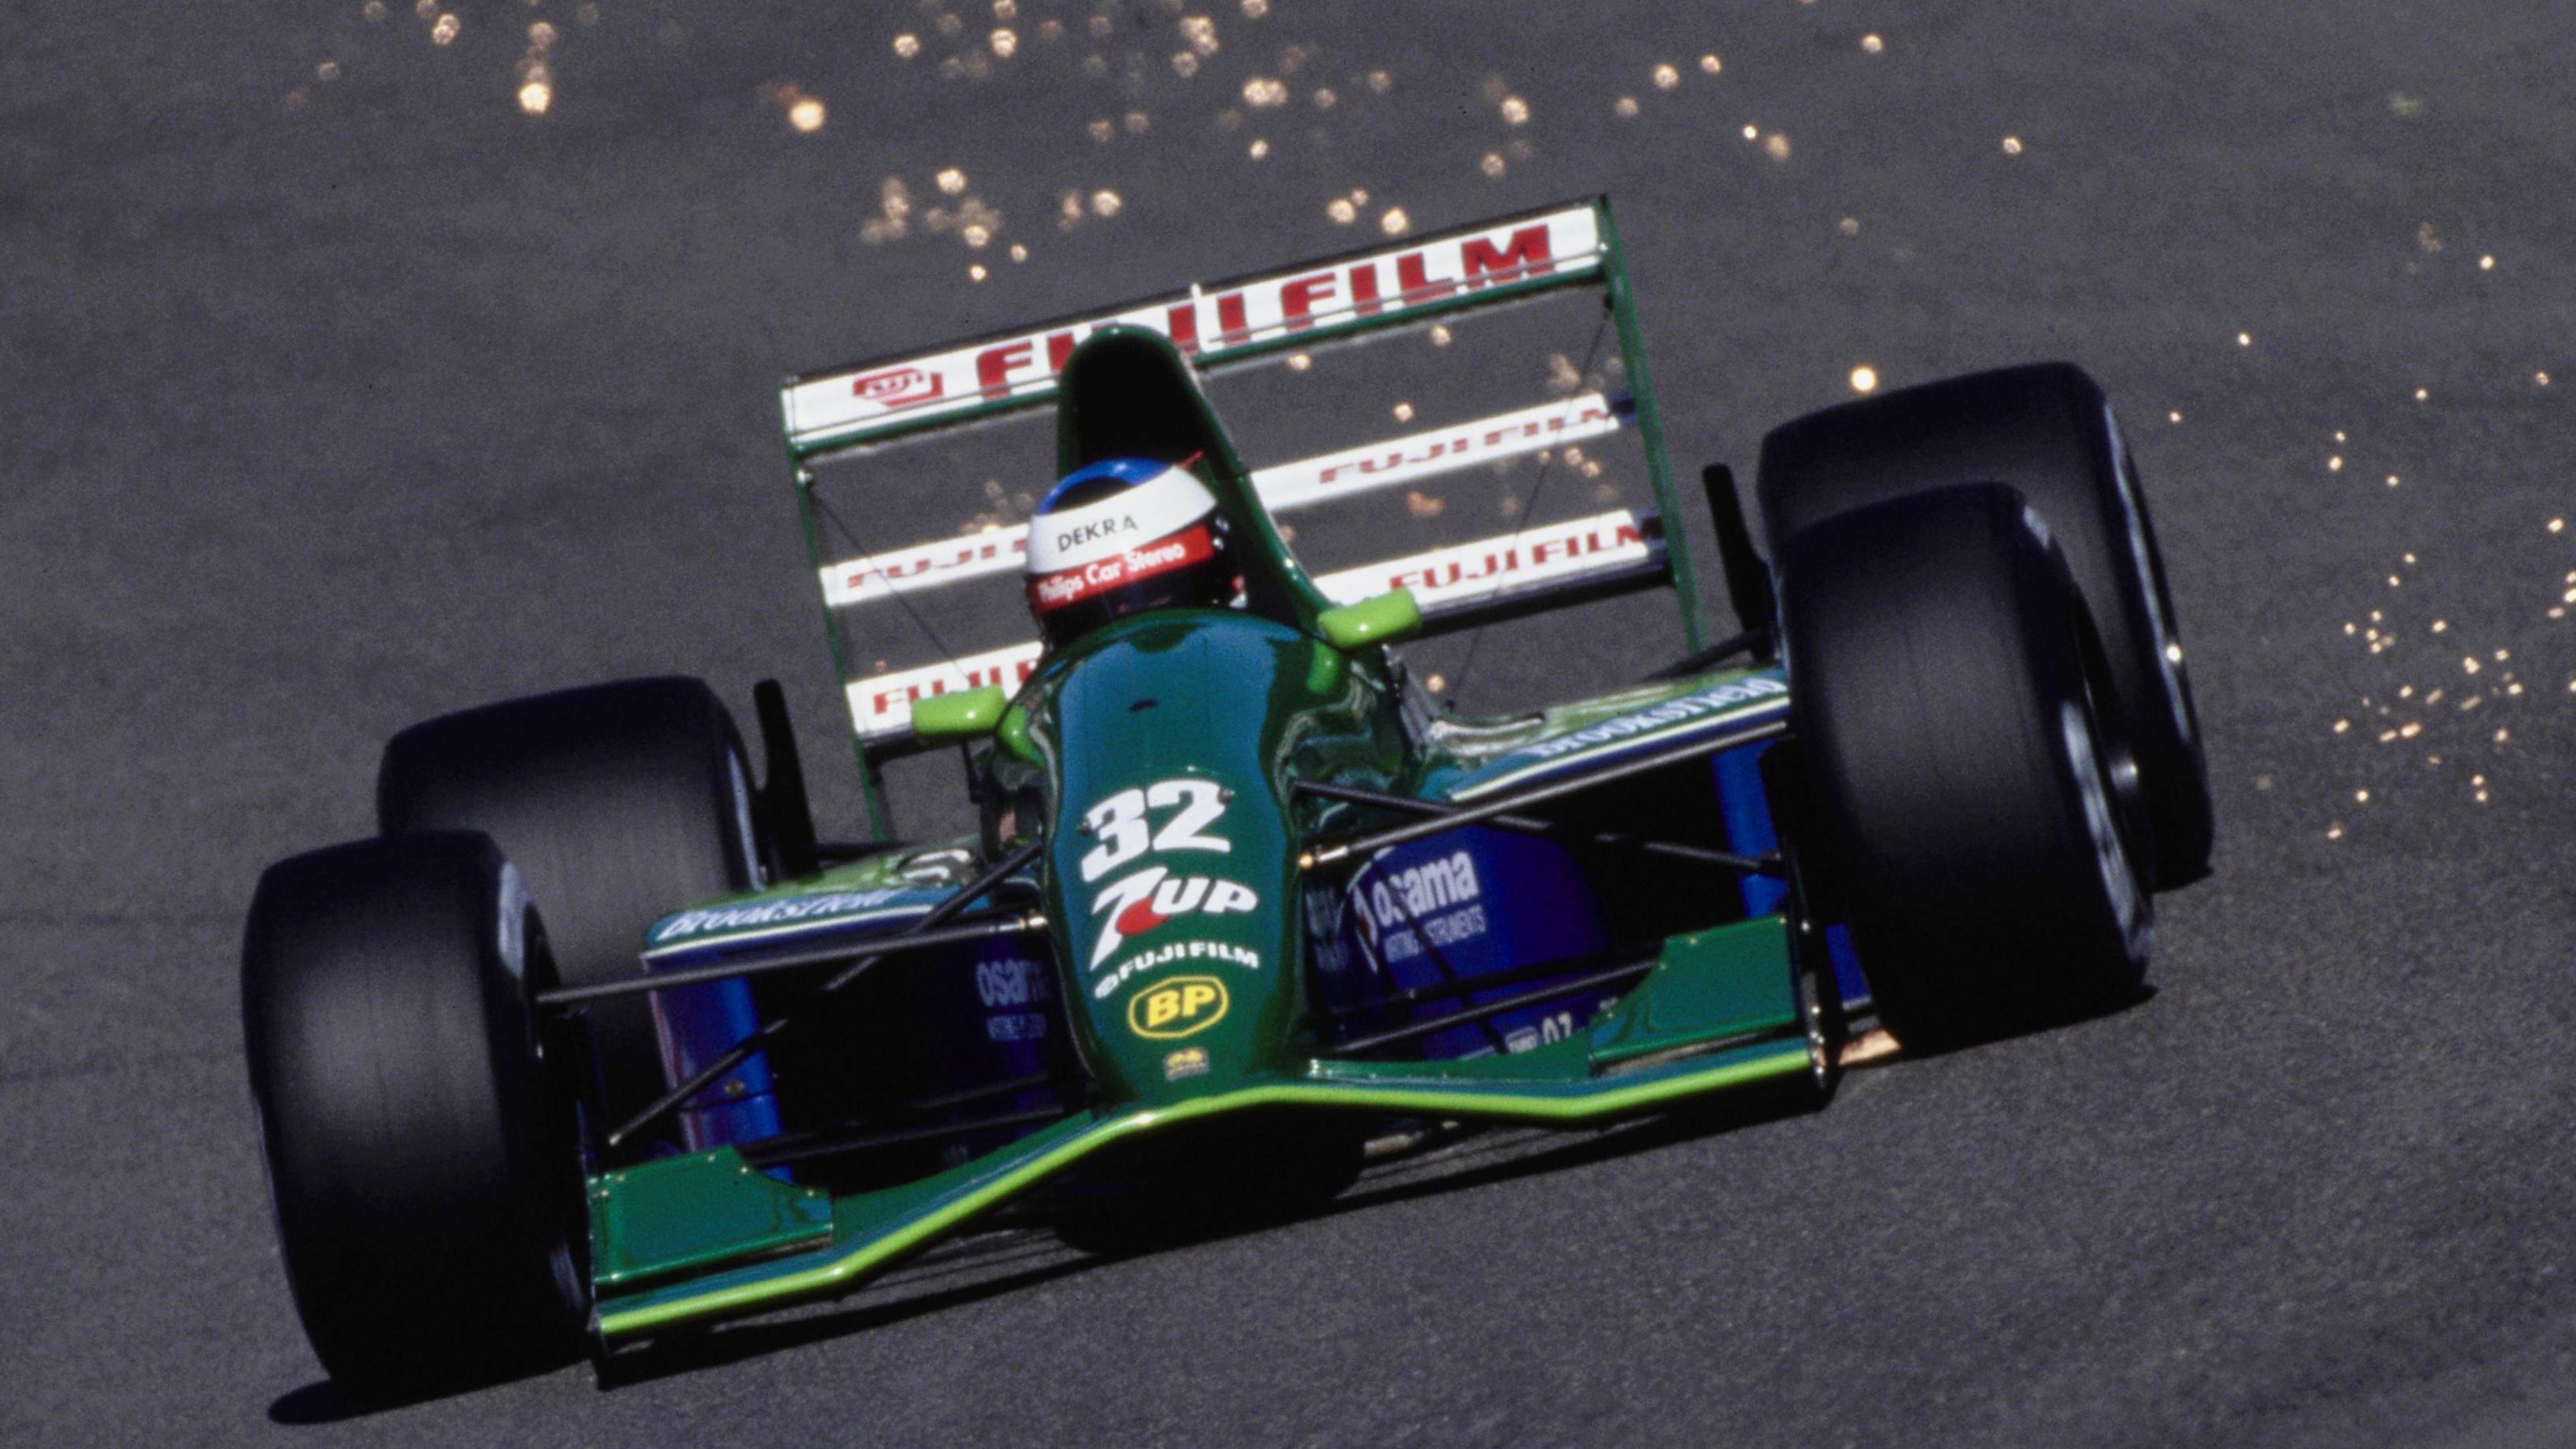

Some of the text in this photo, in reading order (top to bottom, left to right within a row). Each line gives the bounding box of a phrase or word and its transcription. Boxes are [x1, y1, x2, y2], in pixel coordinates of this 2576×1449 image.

[1057, 515, 1138, 552] DEKRA
[1085, 563, 1121, 585] Car
[1125, 543, 1185, 572] Stereo
[1081, 779, 1231, 883] 32
[1090, 867, 1258, 971] 7UP
[1118, 941, 1260, 980] FUJIFILM
[1147, 984, 1218, 1028] BP
